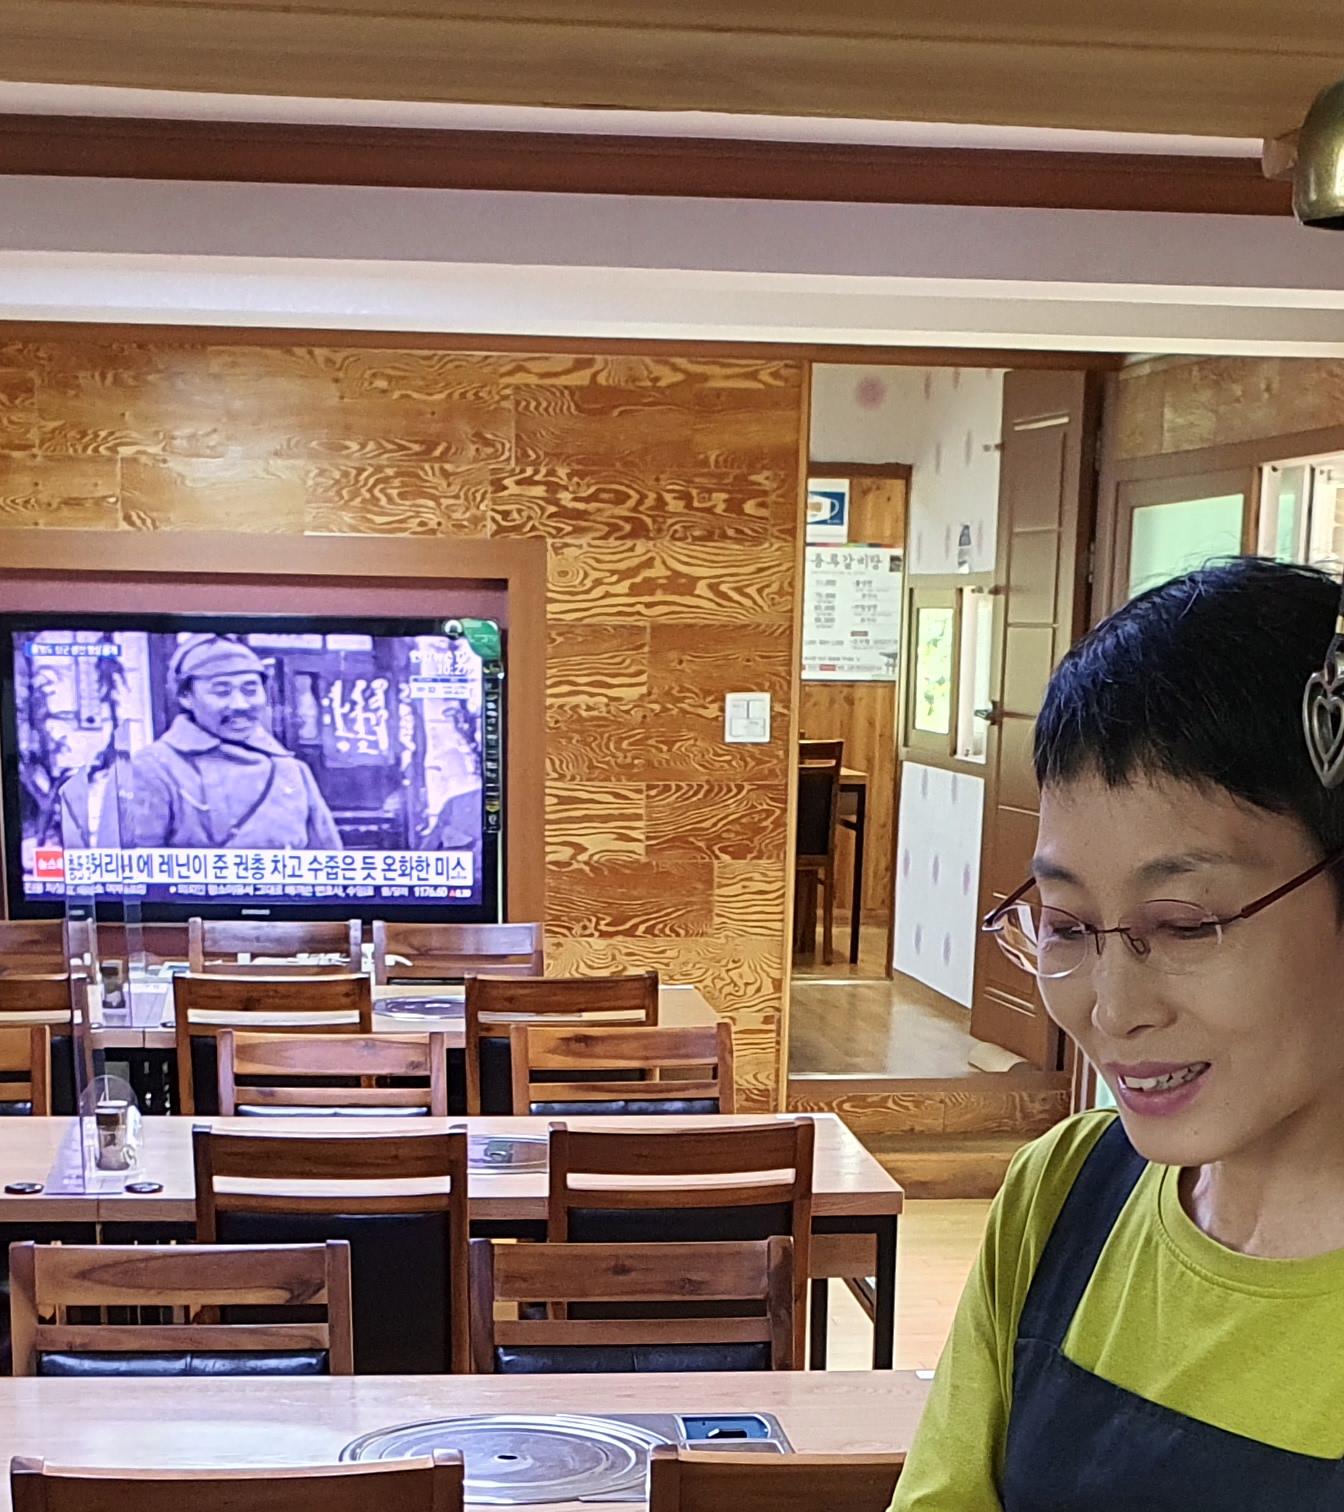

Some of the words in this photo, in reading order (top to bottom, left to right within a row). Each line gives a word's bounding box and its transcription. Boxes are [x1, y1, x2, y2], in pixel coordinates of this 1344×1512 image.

[158, 853, 207, 880] 레닌이
[211, 854, 230, 880] 준
[233, 853, 266, 881] 권총
[270, 854, 304, 881] 차고
[307, 855, 358, 882] 수줍은
[360, 855, 378, 882] 듯
[381, 855, 431, 882] 온화한
[434, 856, 468, 882] 미소
